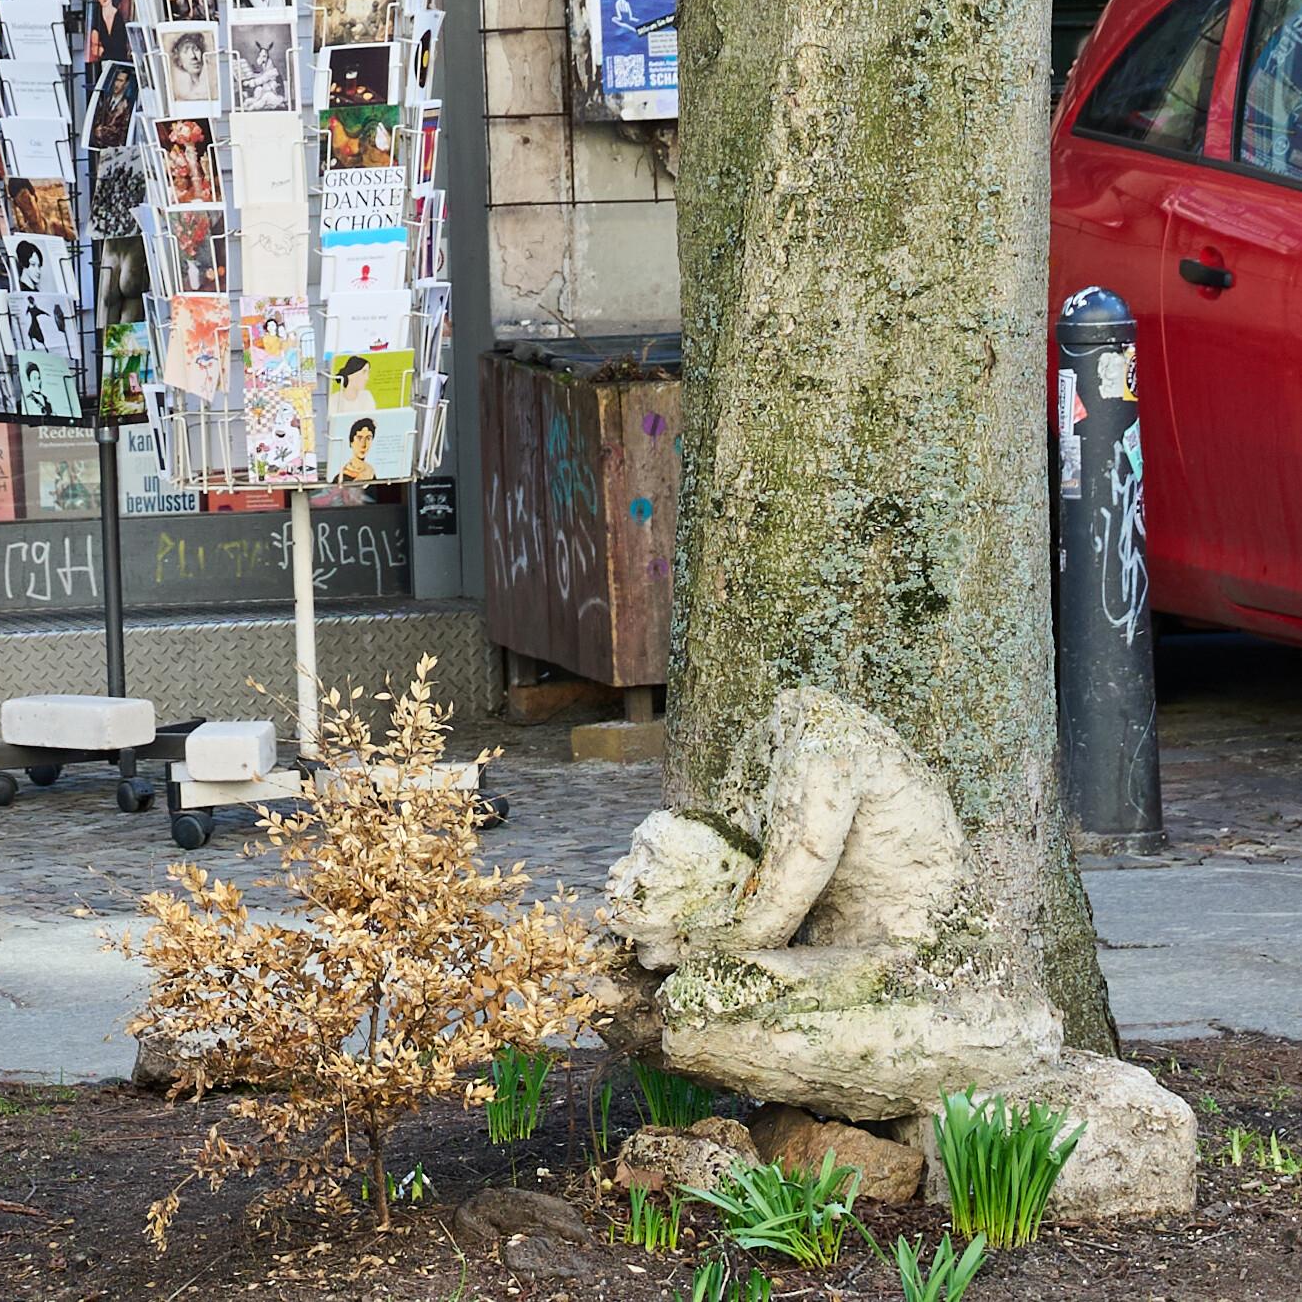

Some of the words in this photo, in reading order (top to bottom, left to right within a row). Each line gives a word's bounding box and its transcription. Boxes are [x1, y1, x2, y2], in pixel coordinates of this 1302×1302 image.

[325, 168, 404, 188] GROSSES
[324, 187, 402, 210] DANKE
[323, 210, 399, 233] SCHÖN
[38, 426, 95, 440] Redeku
[128, 431, 154, 452] kan
[126, 492, 196, 513] bewusste
